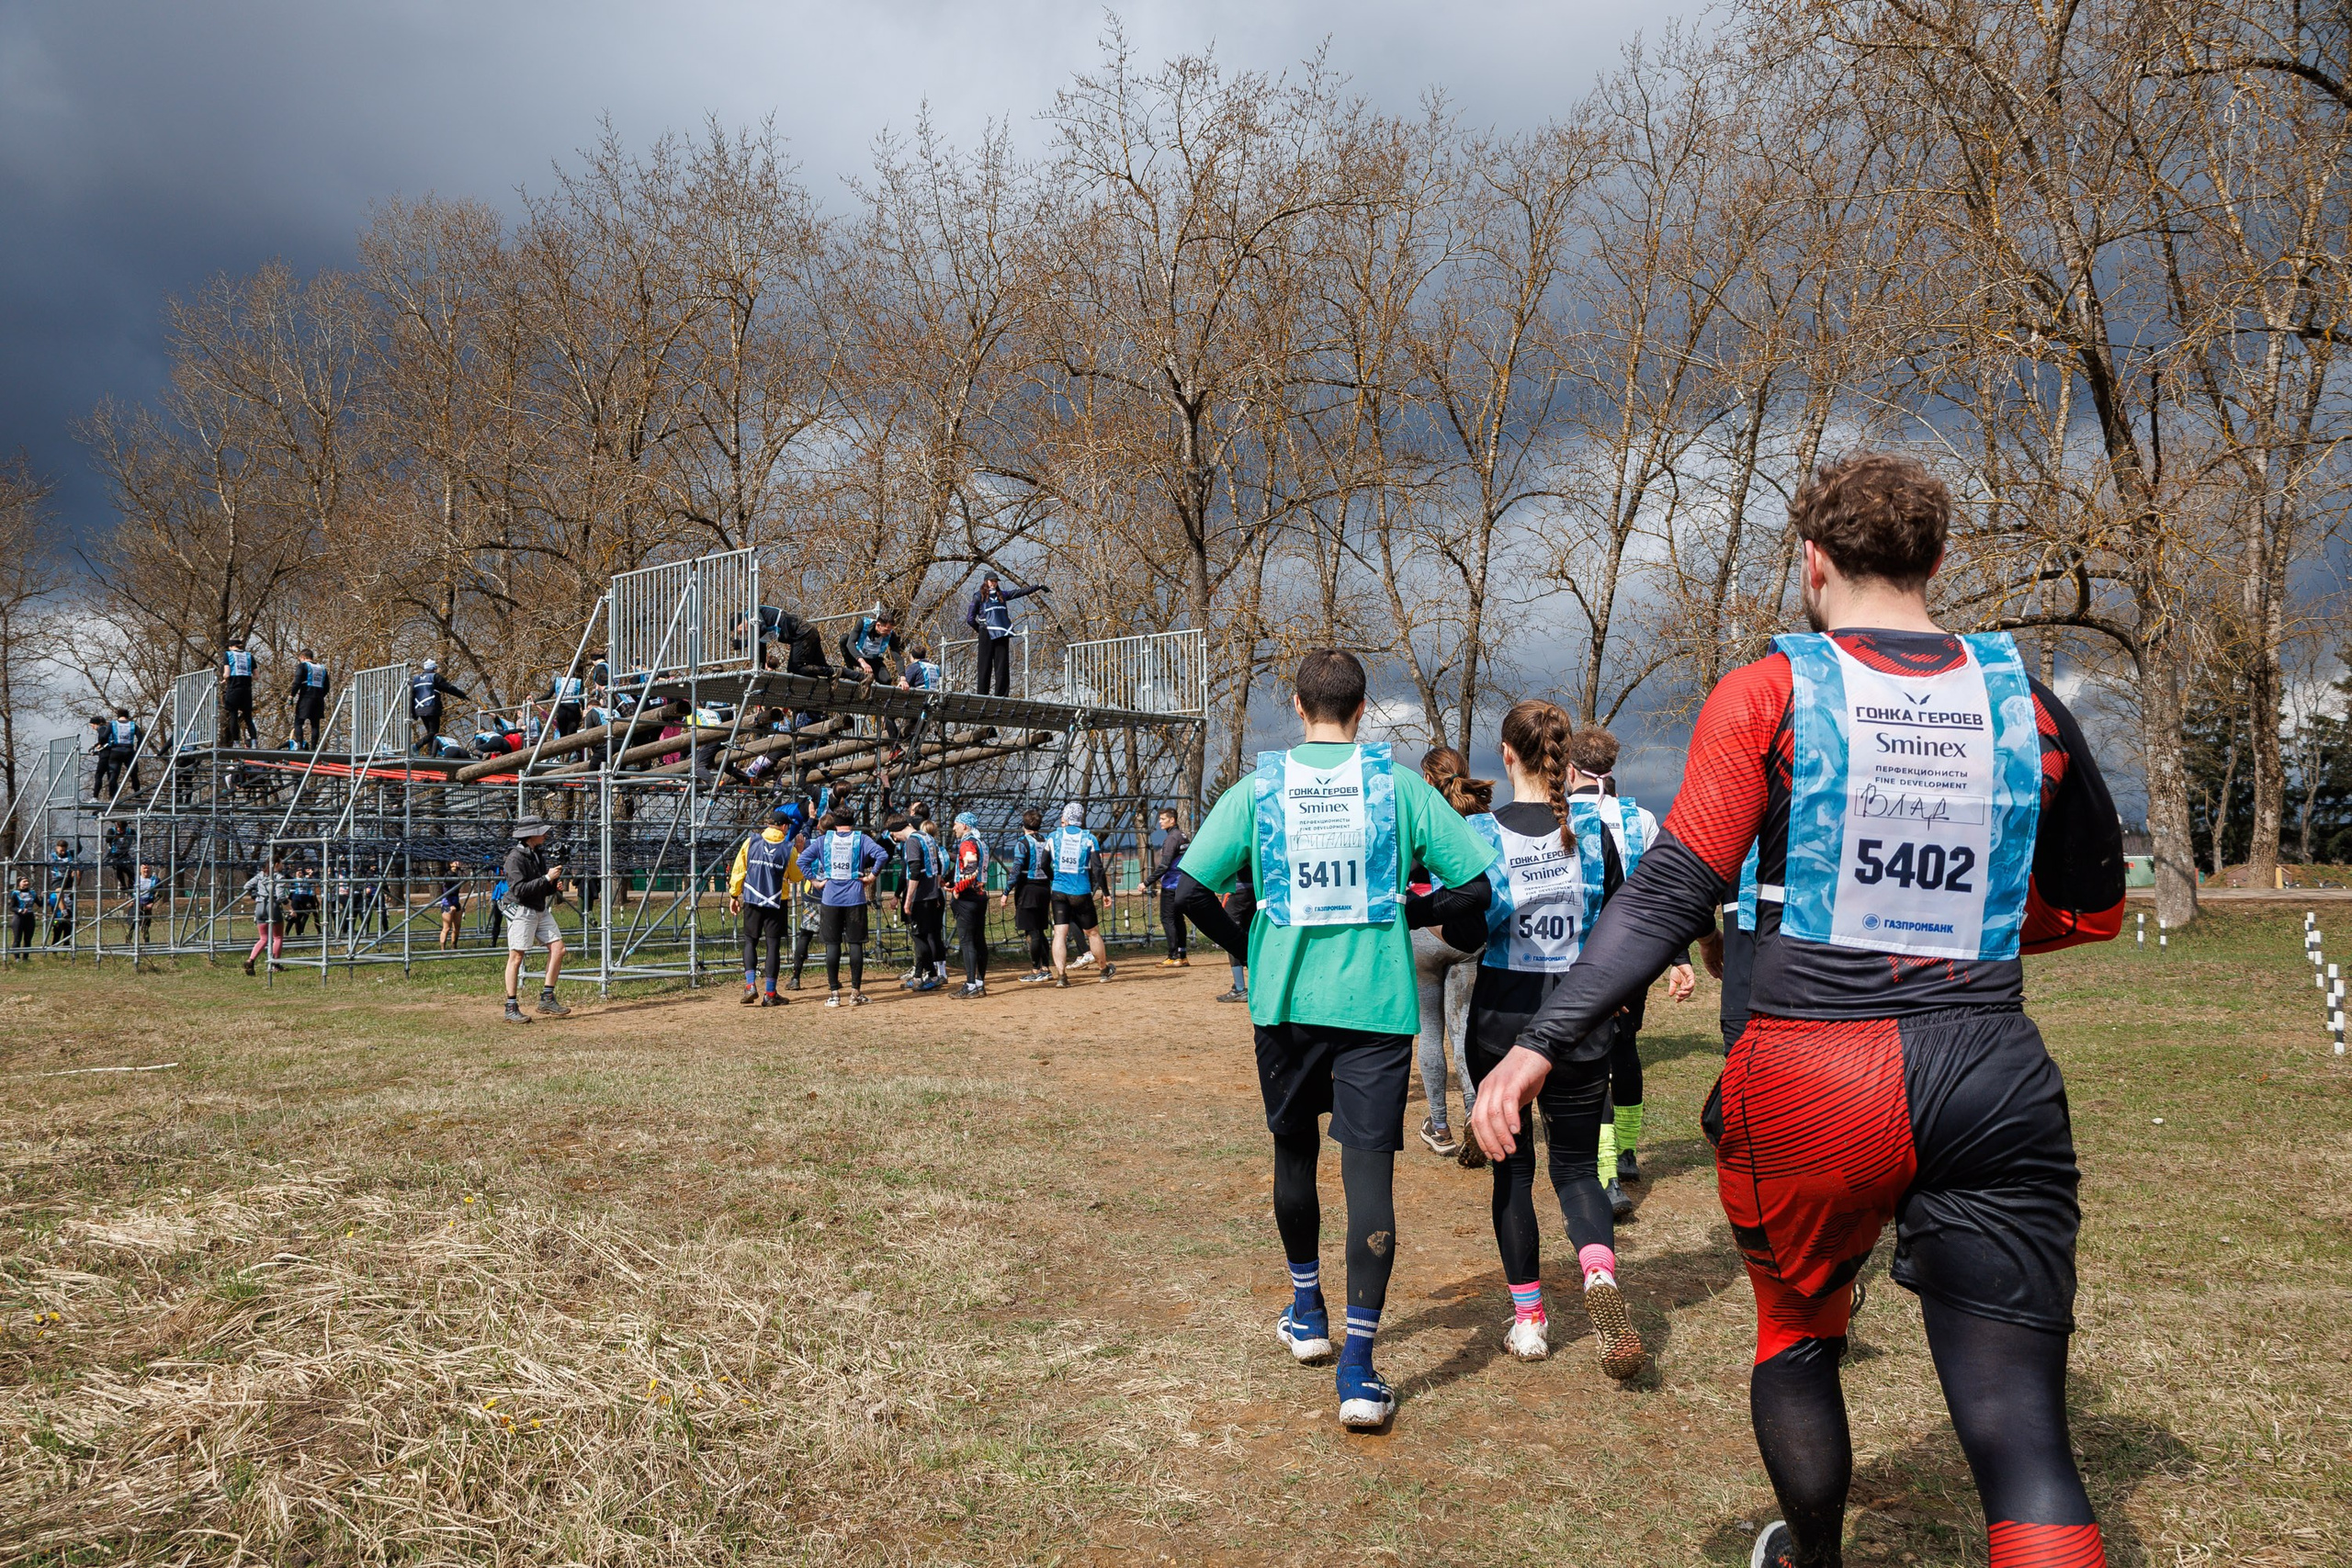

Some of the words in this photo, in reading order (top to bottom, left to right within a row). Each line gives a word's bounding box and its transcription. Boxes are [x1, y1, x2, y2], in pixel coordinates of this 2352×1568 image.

[1856, 706, 1913, 722] ГОНКА
[1918, 711, 1984, 725] ГЕРОЕВ
[1876, 732, 1967, 758] Sminex
[1875, 765, 1968, 778] ПЕРФЕКЦИОНИСТЫ
[1289, 788, 1320, 796] ГОНКА
[1323, 786, 1359, 795] ГЕРОЕВ
[1874, 776, 1895, 785] FINE
[1900, 779, 1968, 789] DEVELOPMENT
[1299, 802, 1350, 814] Sminex
[1860, 783, 1950, 830] ВЛАД
[833, 862, 850, 870] 5429
[1061, 856, 1077, 864] 5435
[1510, 855, 1539, 866] ГОНКА
[1542, 848, 1576, 861] ГЕРОЕВ
[1854, 839, 1975, 893] 5402
[1298, 860, 1357, 888] 5411
[1521, 865, 1569, 883] Sminex
[1519, 914, 1575, 940] 5401
[1883, 919, 1954, 933] ГАЗПРОМБАНК
